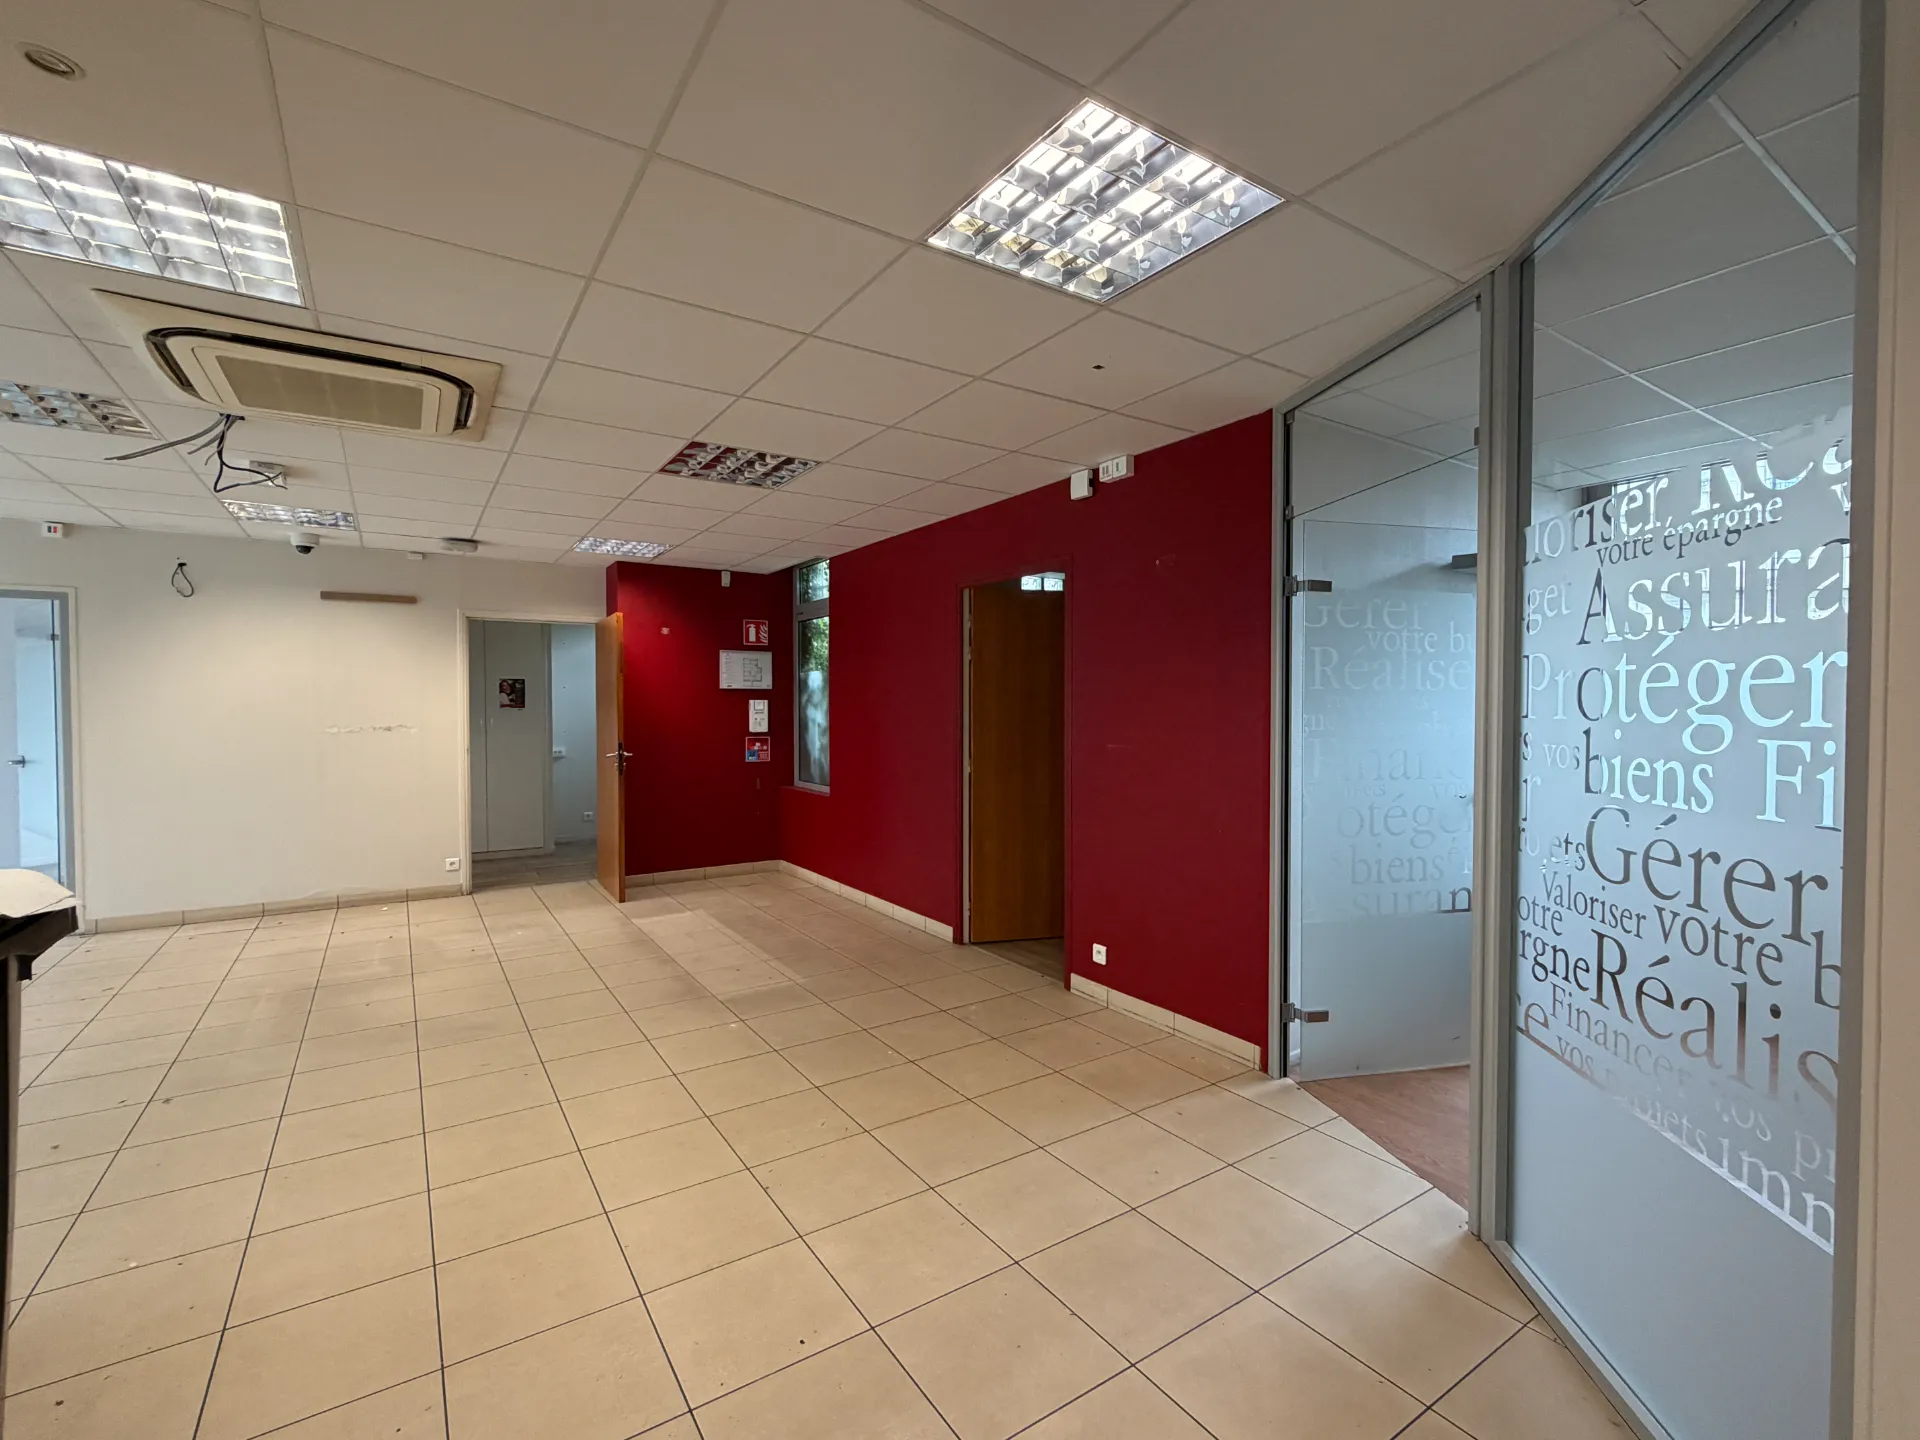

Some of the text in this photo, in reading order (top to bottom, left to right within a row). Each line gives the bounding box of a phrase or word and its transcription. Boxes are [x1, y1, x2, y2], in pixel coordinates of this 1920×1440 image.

[1596, 533, 1654, 567] votre
[1663, 497, 1782, 559] épargne
[1576, 537, 1851, 645] Assura
[1521, 634, 1848, 756] Protéger
[1583, 727, 1715, 814] biens
[1541, 868, 1648, 940] Valoriser
[1654, 905, 1784, 987] votre
[1585, 804, 1830, 947] Gérer
[1550, 982, 1693, 1088] Financer
